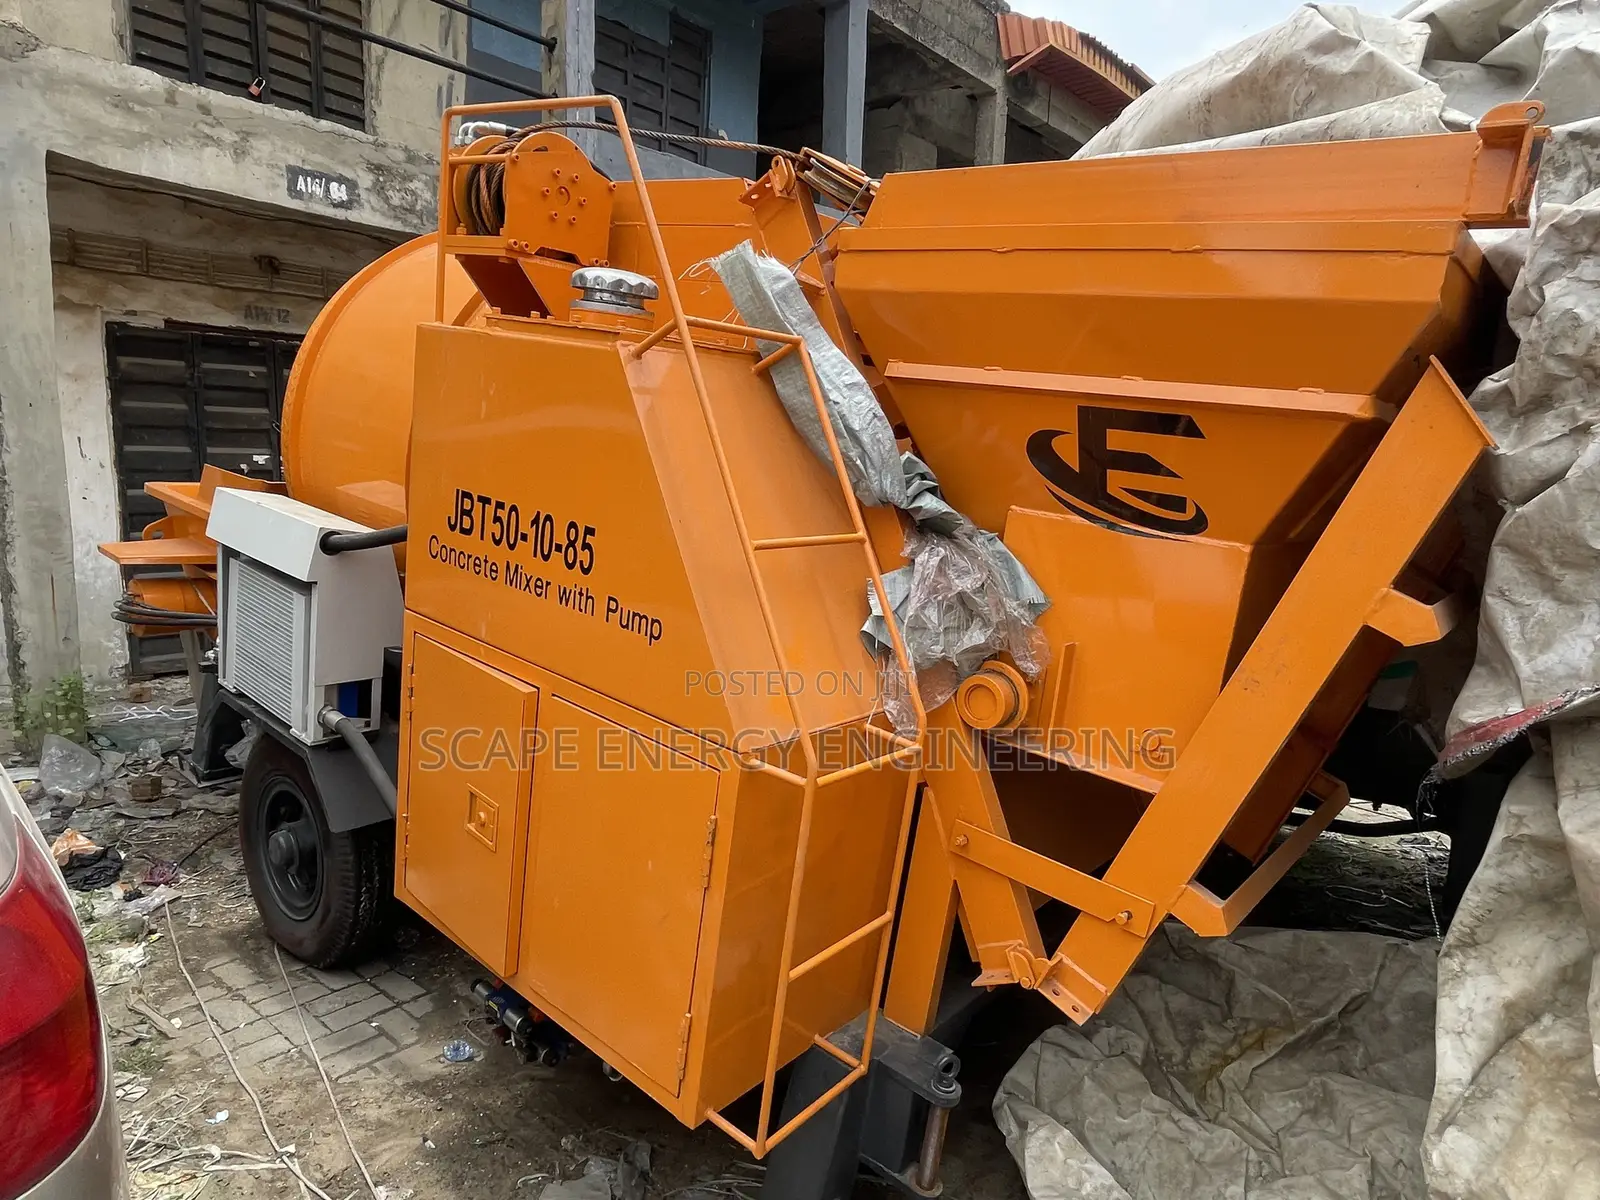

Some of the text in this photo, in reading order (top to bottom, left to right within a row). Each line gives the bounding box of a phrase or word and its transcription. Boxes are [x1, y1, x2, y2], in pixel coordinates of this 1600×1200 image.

[447, 488, 597, 576] JBT50-10-85
[428, 534, 663, 646] Concrete Mixer with Pump
